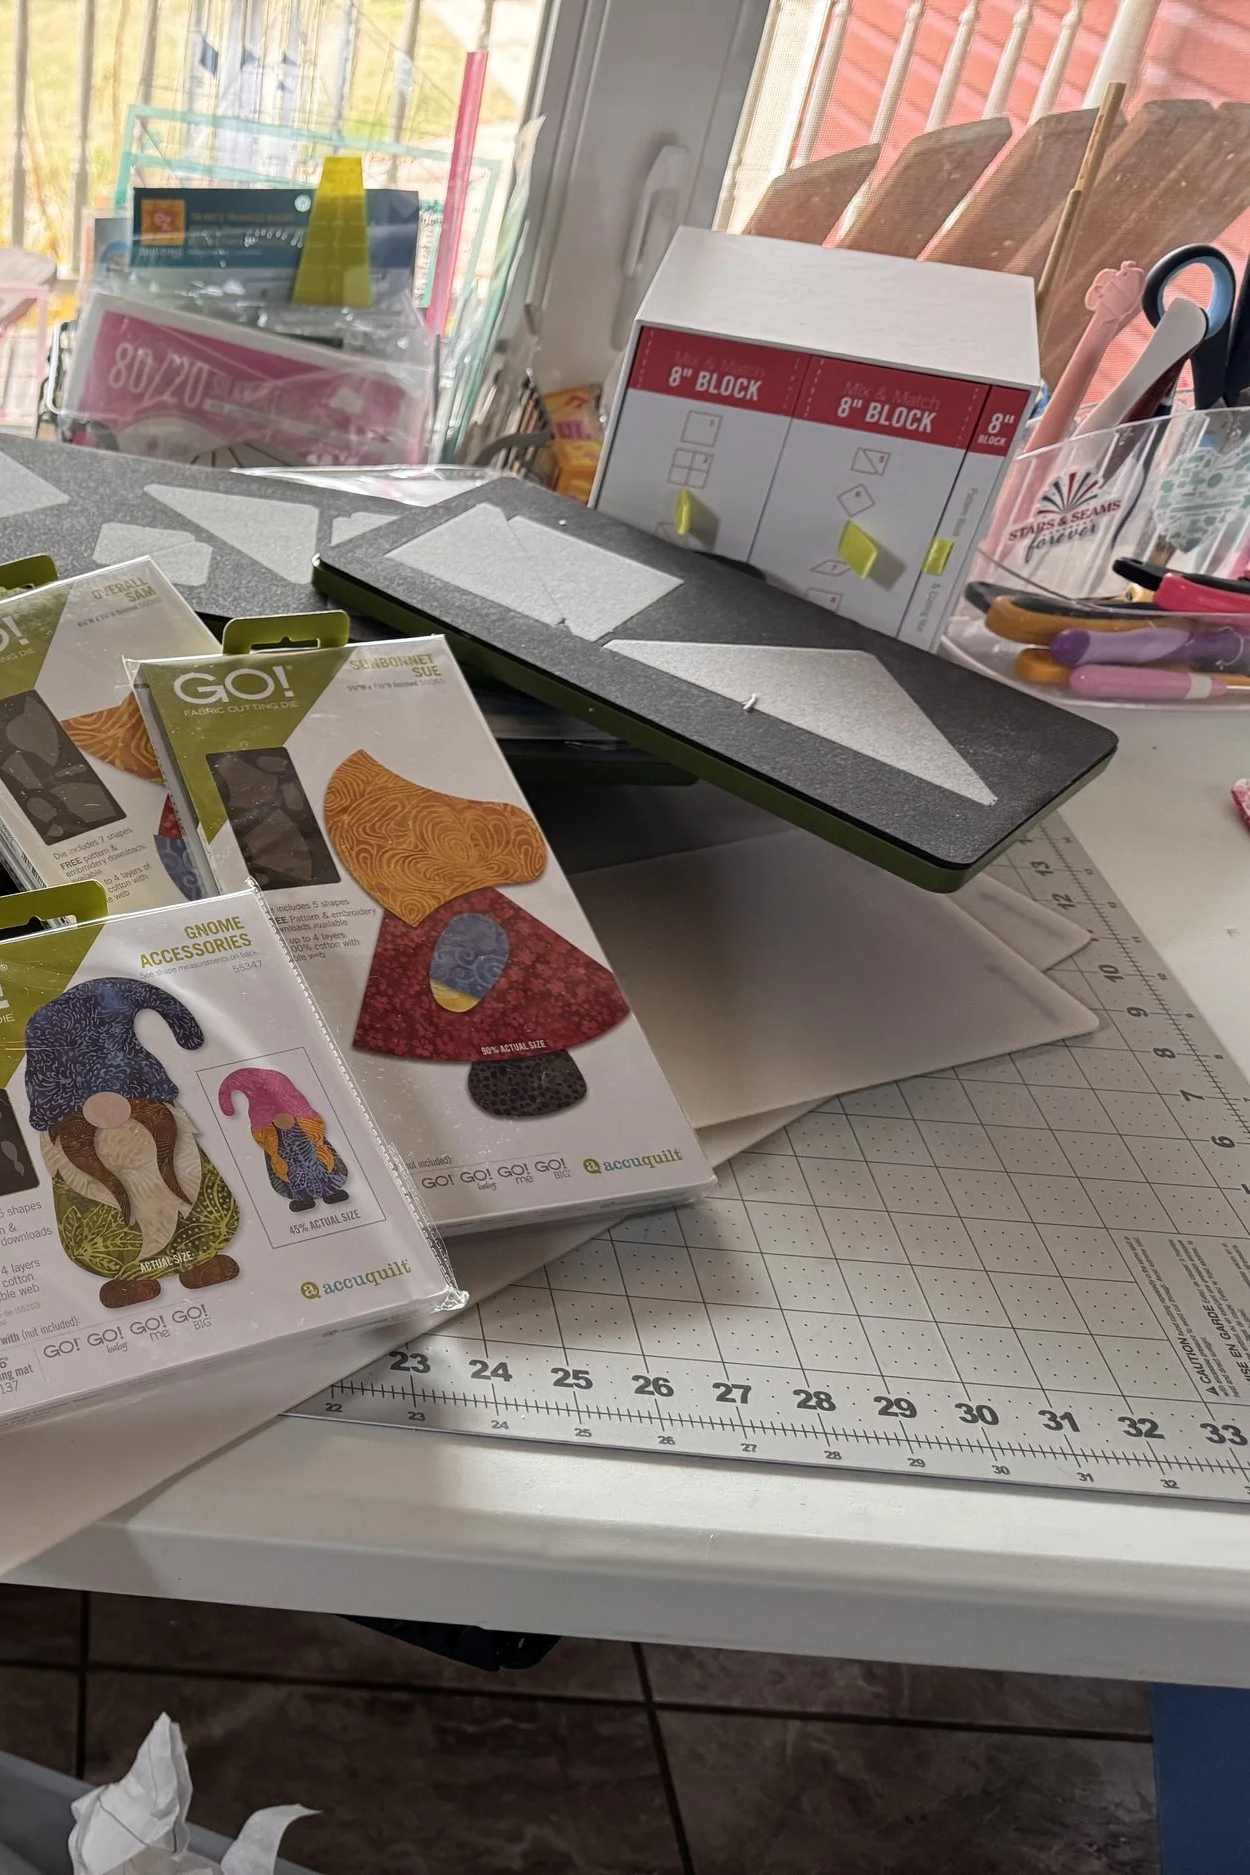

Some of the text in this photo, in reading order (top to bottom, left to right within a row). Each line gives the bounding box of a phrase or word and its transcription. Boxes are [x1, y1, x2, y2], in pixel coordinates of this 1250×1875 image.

[108, 342, 209, 408] 80/20
[669, 366, 762, 401] 8" BLOCK
[838, 397, 936, 434] 8" BLOCK
[988, 413, 1013, 433] 8"
[978, 434, 1006, 446] BLOCK
[1008, 500, 1121, 541] STARS & SEAMS
[1025, 524, 1095, 564] forever
[125, 586, 156, 602] SAM
[350, 653, 434, 670] SUNBONNET
[412, 665, 442, 677] SUE
[174, 666, 294, 704] GO!
[183, 707, 224, 716] FABRIC
[228, 702, 279, 713] CUTTING
[1030, 861, 1053, 877] 13
[1052, 893, 1076, 910] 12
[184, 916, 244, 939] GNOME
[140, 933, 251, 968] ACCESSORIES
[232, 960, 262, 974] 55347
[1099, 965, 1124, 982] 10
[1127, 1007, 1149, 1017] 9
[481, 1040, 546, 1055] 90% ACTUAL SIZE
[1153, 1048, 1176, 1058] 8
[1179, 1090, 1205, 1101] 7
[1211, 1136, 1235, 1148] 6
[604, 1149, 682, 1172] accuquilt
[422, 1158, 566, 1189] GO! GO! GO! GO!
[7, 1201, 42, 1216] shapes
[9, 1223, 17, 1232] &
[289, 1209, 361, 1236] 45% ACTUAL SIZE
[1, 1227, 52, 1246] downloads
[1, 1266, 8, 1275] 4
[11, 1259, 40, 1274] layers
[140, 1251, 193, 1272] ACTUAL SIZE
[3, 1274, 34, 1287] cotton
[323, 1260, 411, 1295] accuquilt
[19, 1284, 39, 1295] web
[1, 1333, 20, 1344] with
[22, 1328, 38, 1341] (not
[40, 1316, 81, 1335] included):
[44, 1304, 208, 1358] GO! GO! GO! GO!
[1203, 1304, 1242, 1358] EN GARDE
[1177, 1337, 1211, 1384] CAUTION
[15, 1364, 33, 1376] mat
[389, 1351, 1248, 1445] 23 24 25 26 27 28 29 30 31 32 33
